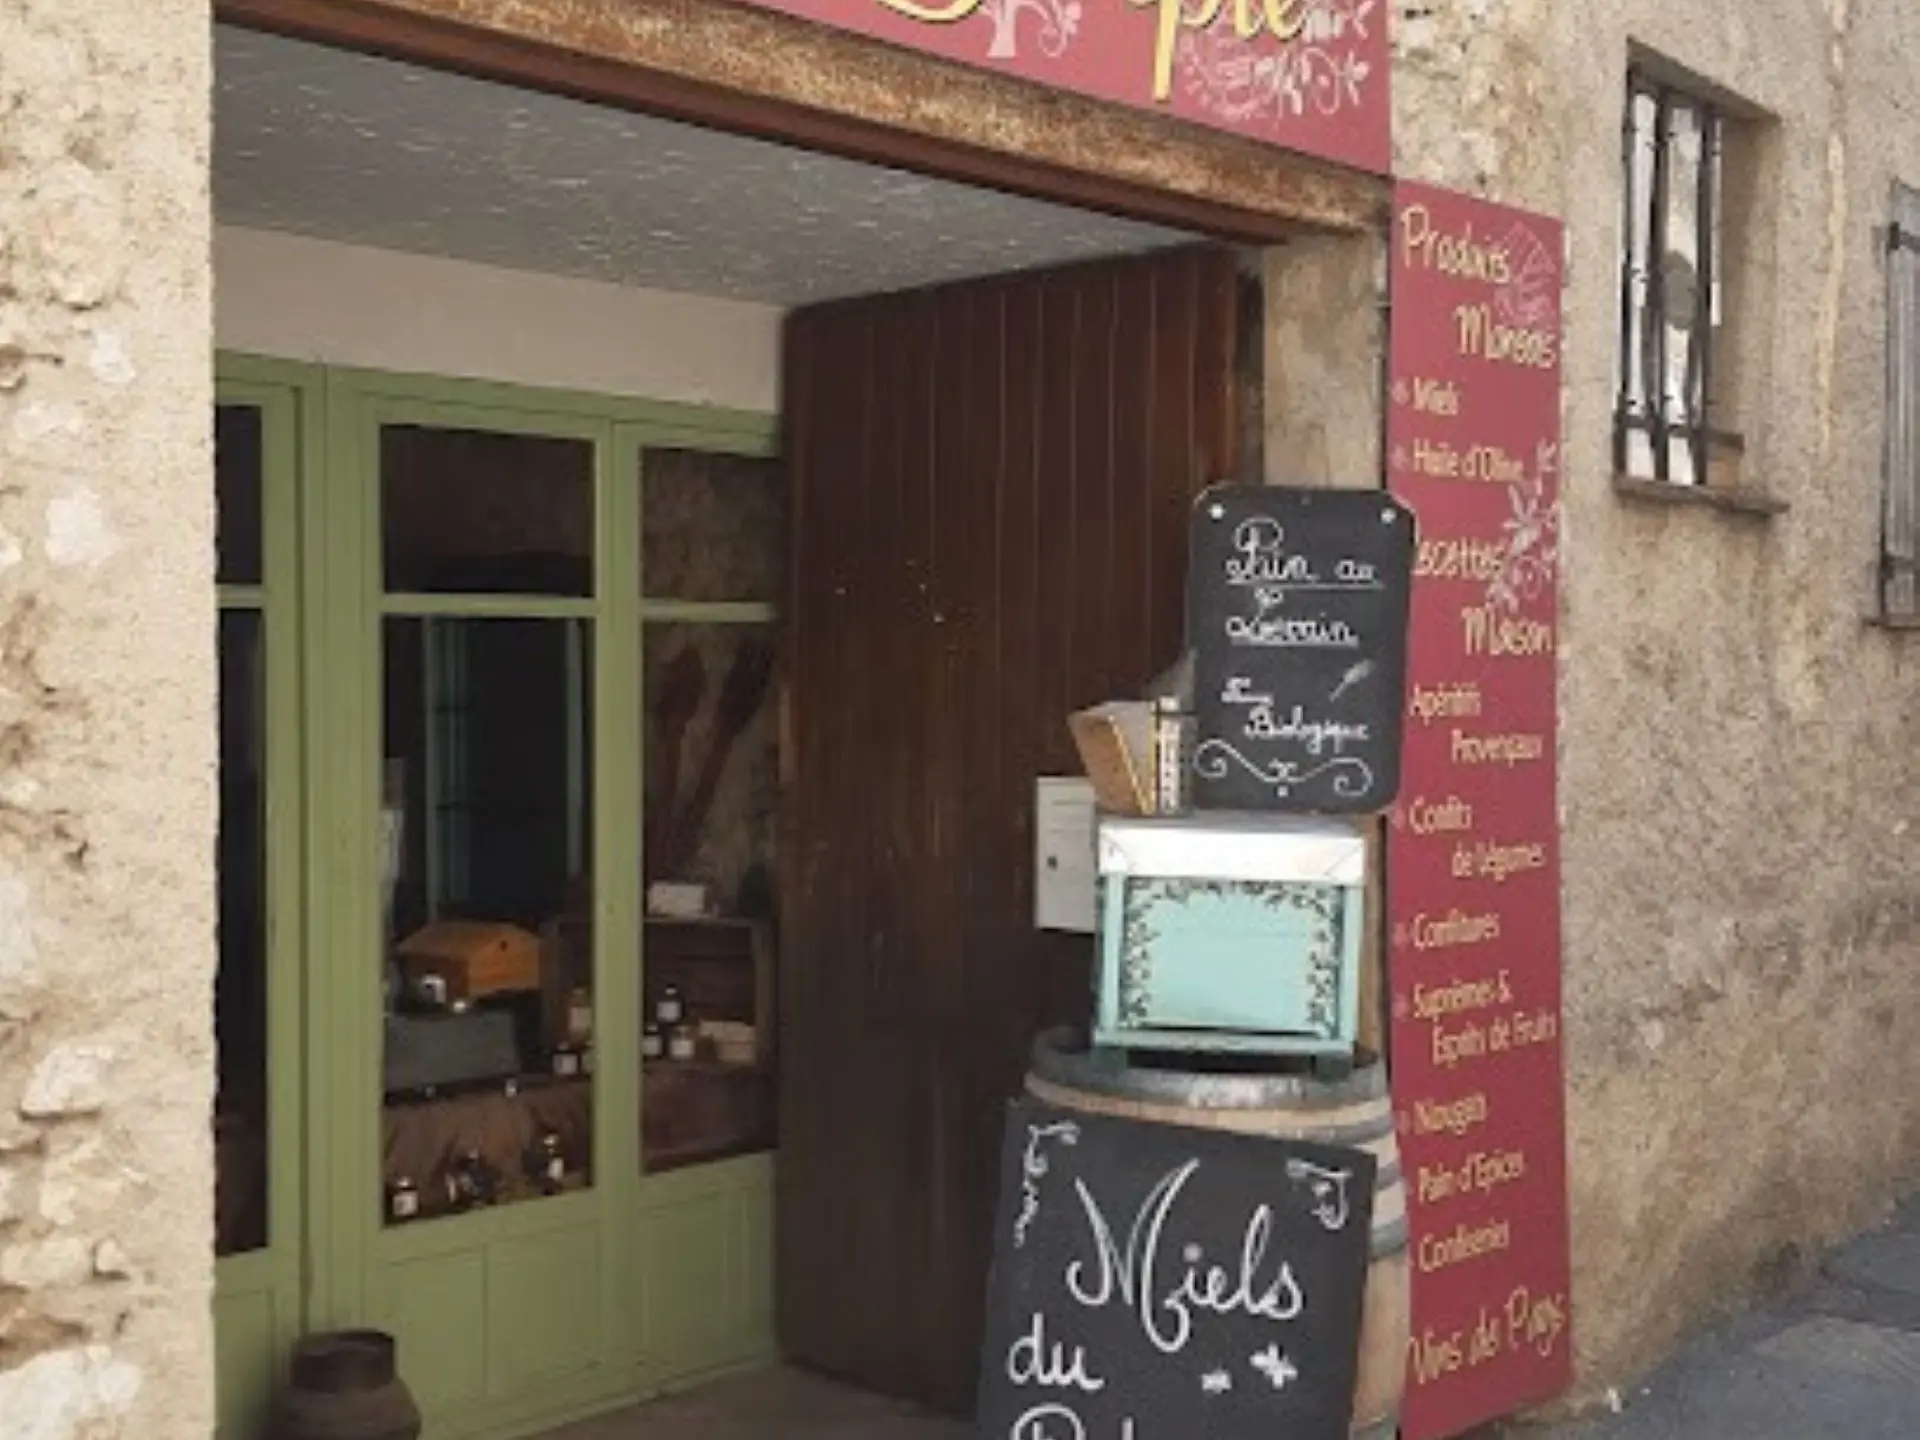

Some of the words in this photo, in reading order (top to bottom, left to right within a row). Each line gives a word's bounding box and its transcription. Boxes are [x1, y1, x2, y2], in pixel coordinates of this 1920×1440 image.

[1400, 204, 1510, 284] Produits
[1411, 536, 1507, 582] ecettes
[1066, 1157, 1305, 1352] Miels
[1007, 1312, 1104, 1391] du
